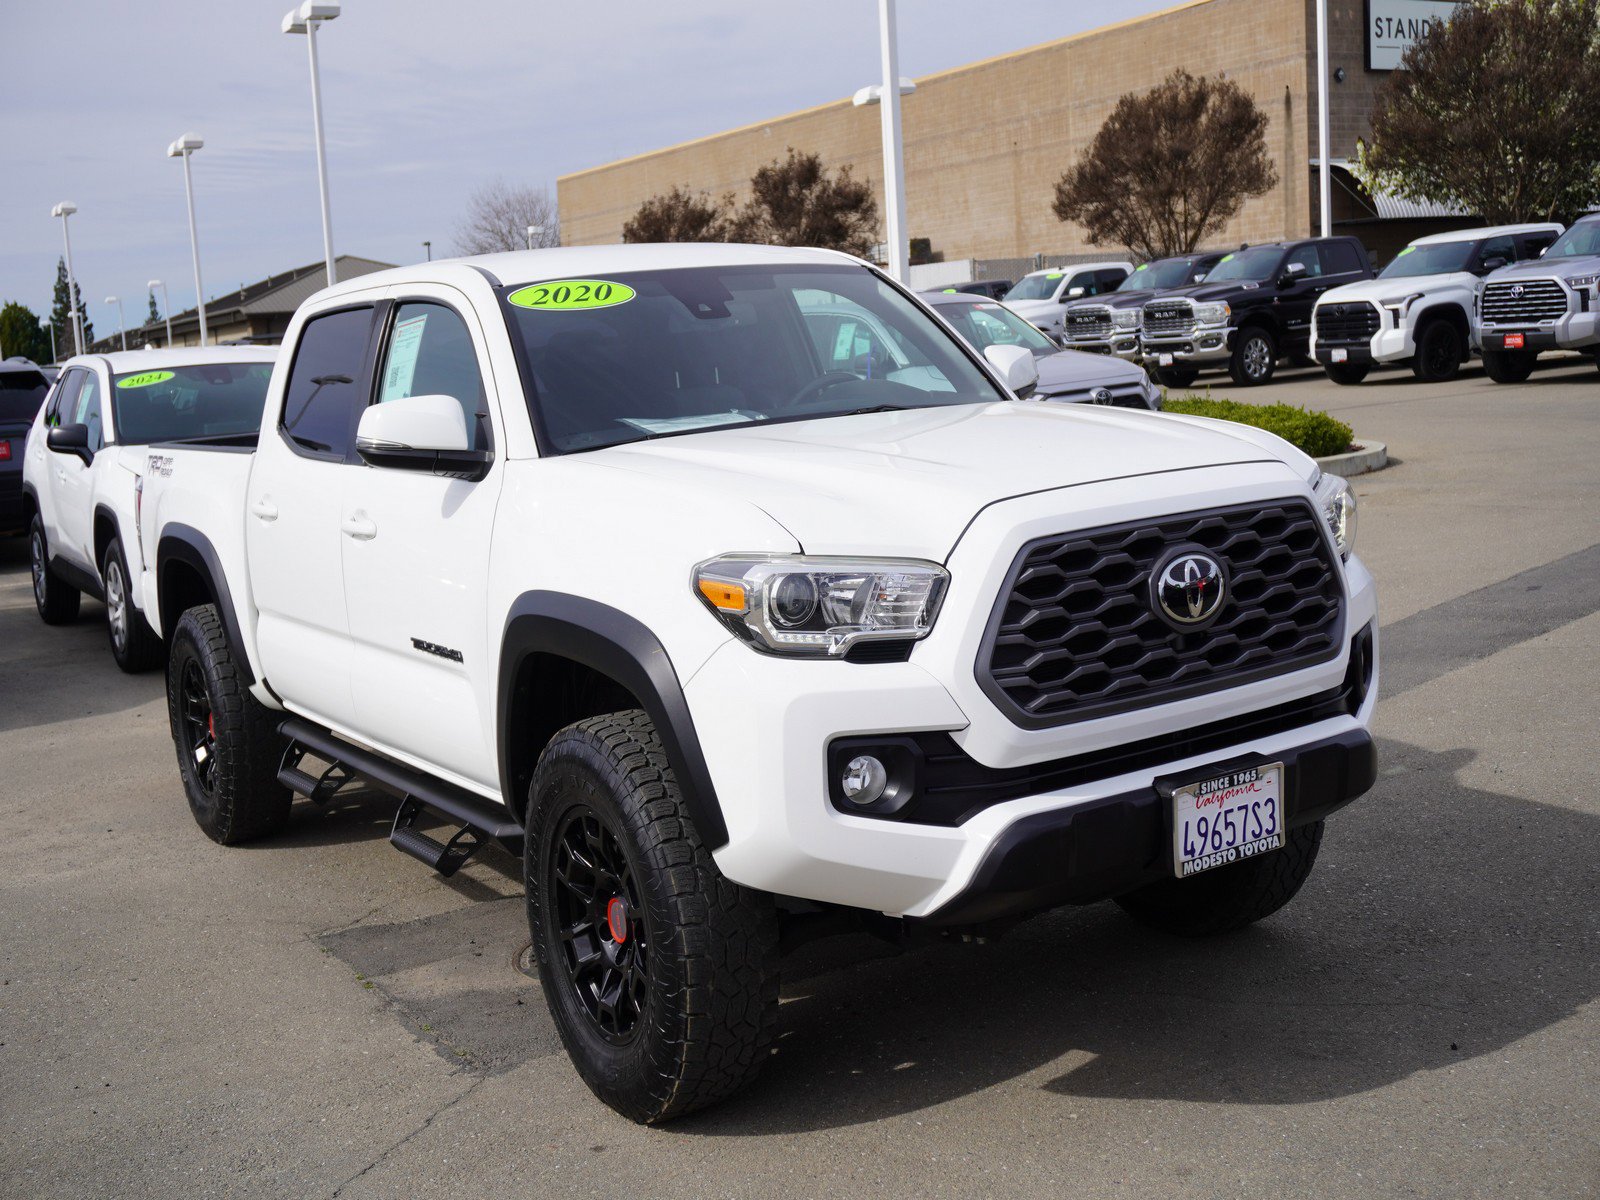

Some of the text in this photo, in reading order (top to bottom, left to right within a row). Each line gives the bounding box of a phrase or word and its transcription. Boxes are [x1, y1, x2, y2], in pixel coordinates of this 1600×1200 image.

[532, 284, 613, 306] 2020
[127, 372, 163, 387] 2024
[1195, 782, 1262, 809] California
[1200, 770, 1257, 795] SINCE 1965
[1183, 798, 1276, 858] 49657S3
[1183, 835, 1280, 875] MODESTO TOYOTA
